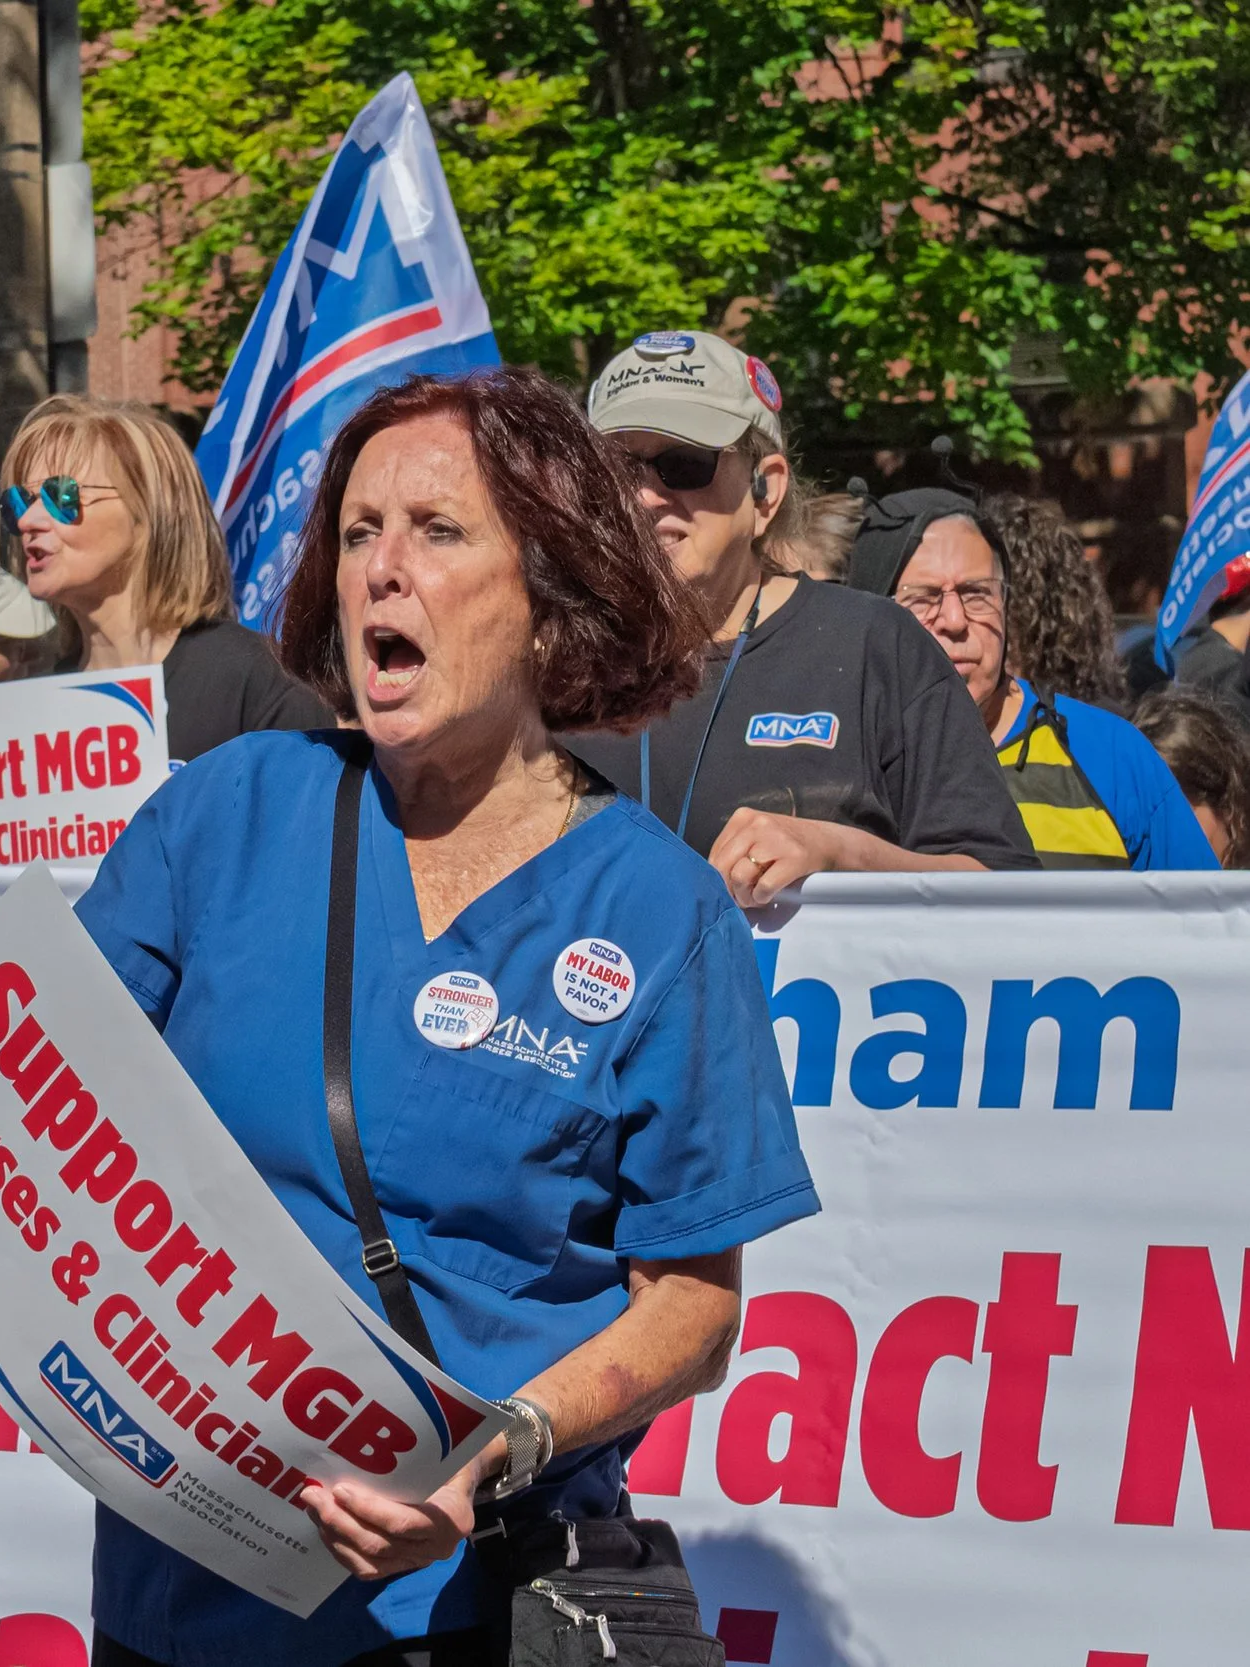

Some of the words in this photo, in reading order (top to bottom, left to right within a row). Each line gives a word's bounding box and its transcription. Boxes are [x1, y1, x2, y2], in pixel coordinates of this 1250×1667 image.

[654, 374, 705, 388] Women's
[754, 718, 823, 738] MNA
[34, 724, 142, 795] MGB
[590, 945, 617, 962] MNA
[450, 976, 475, 987] MNA
[564, 972, 578, 983] IS
[579, 978, 608, 996] NOT
[609, 992, 618, 1003] A
[565, 952, 589, 971] MY
[587, 961, 630, 991] LABOR
[428, 986, 494, 1008] STRONGER
[434, 1003, 466, 1017] THAN
[565, 987, 609, 1013] FAVOR
[421, 1013, 470, 1034] EVER
[478, 1043, 513, 1058] URSES
[514, 1054, 577, 1078] ASSOCIATION
[52, 1240, 100, 1306] &
[93, 1293, 323, 1511] Clinician
[211, 1293, 417, 1475] MGB
[47, 1351, 147, 1467] MNA
[174, 1480, 235, 1523] Nurses
[182, 1471, 310, 1554] Massachusetts
[166, 1491, 270, 1556] Association
